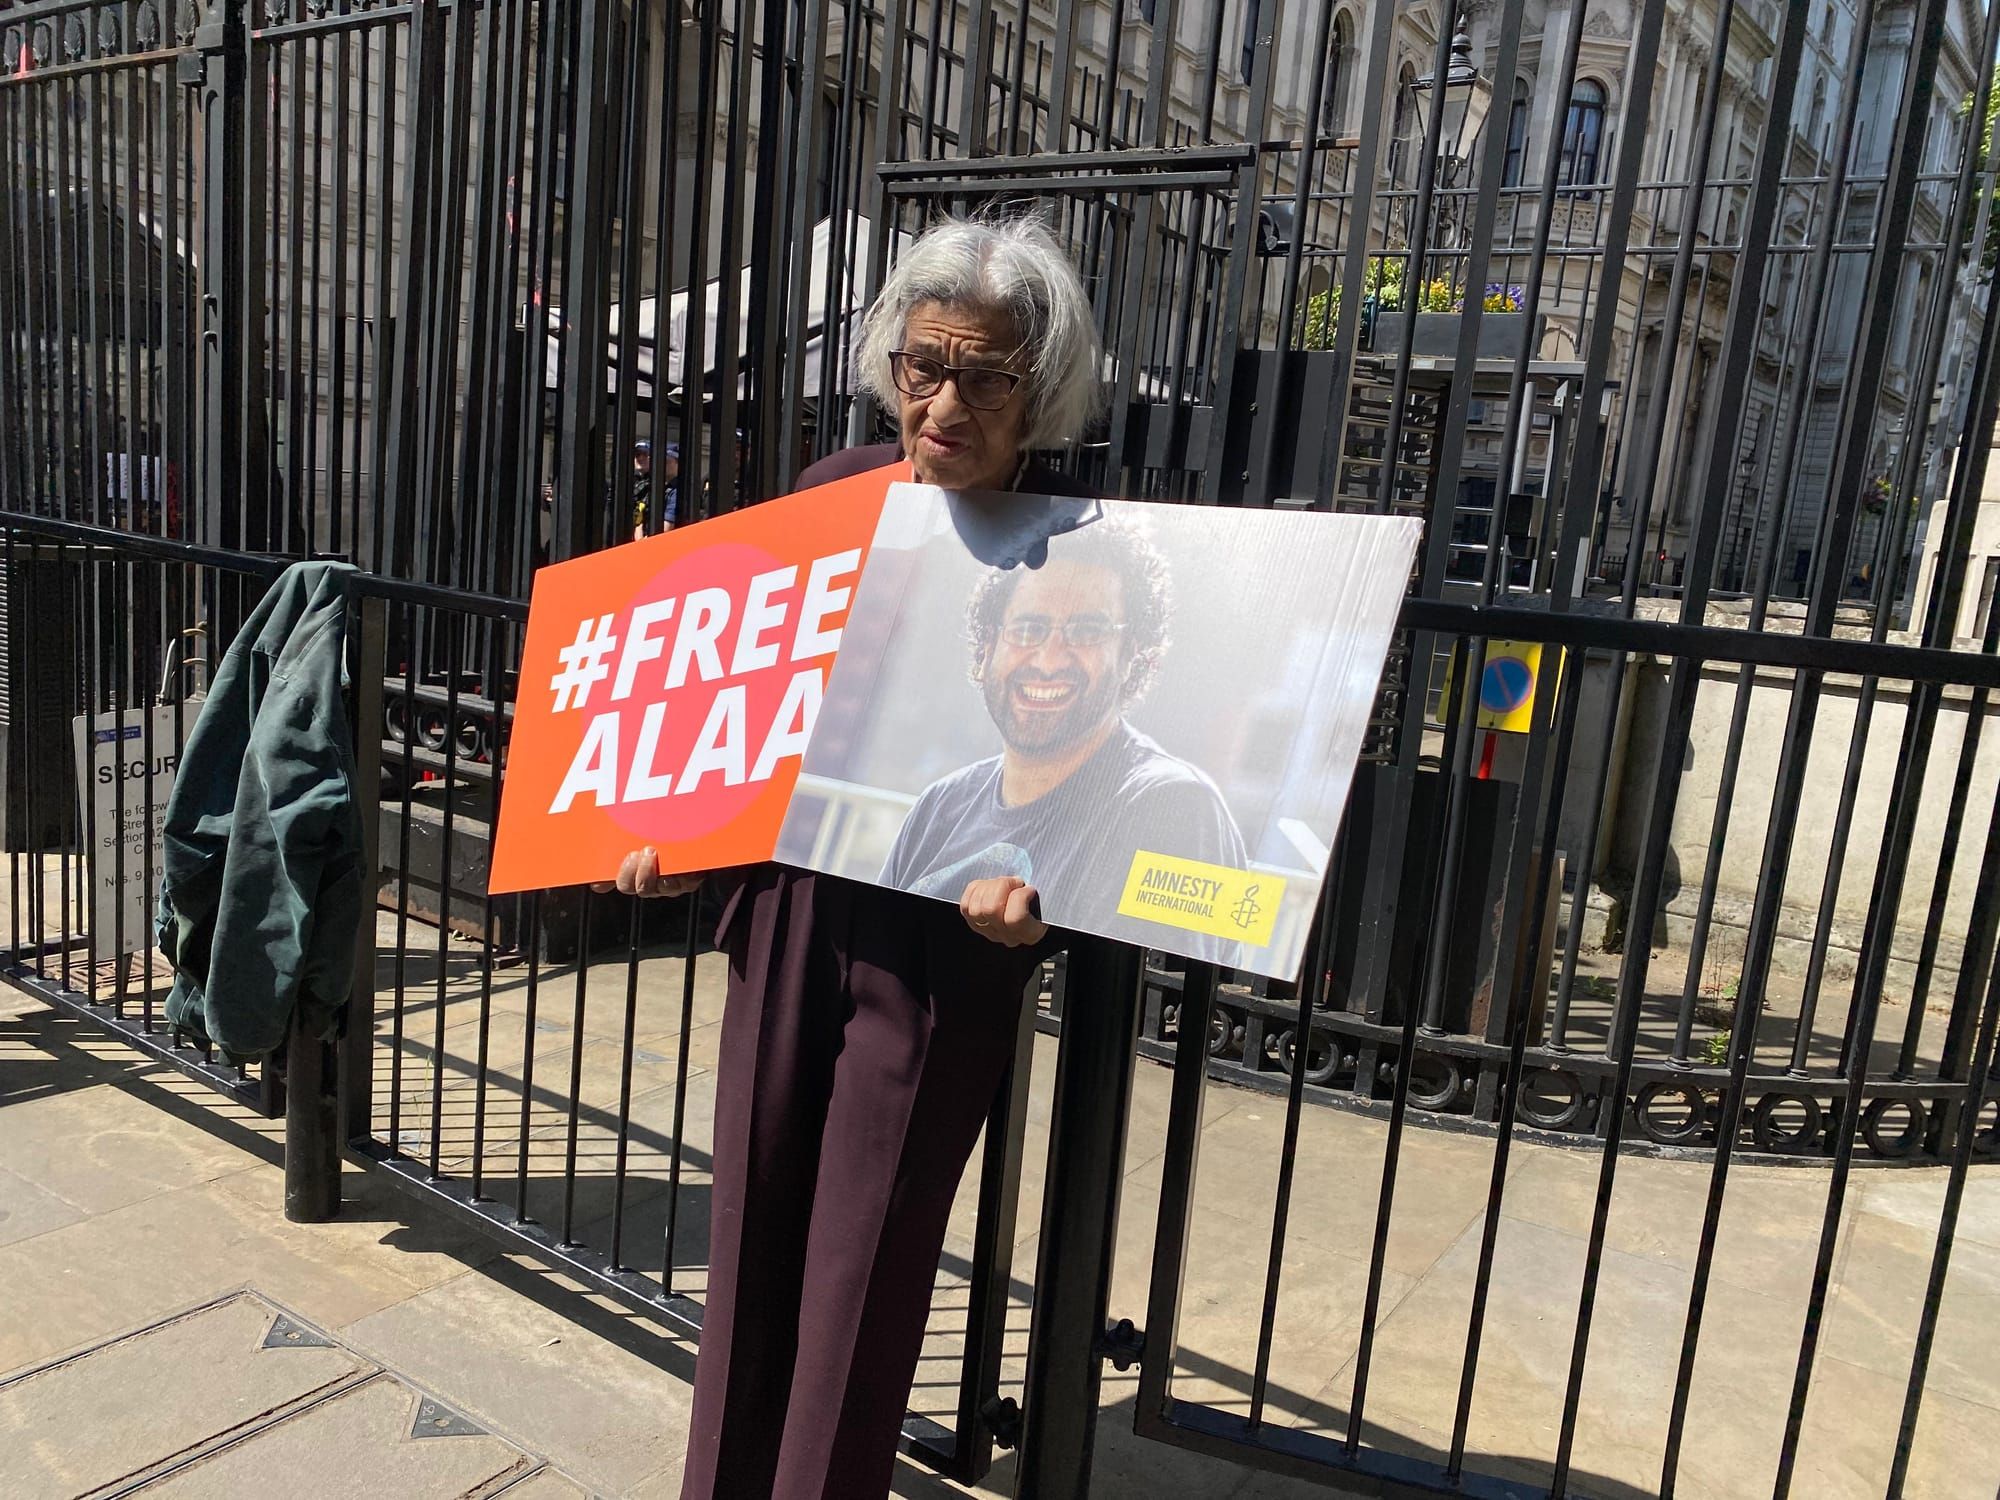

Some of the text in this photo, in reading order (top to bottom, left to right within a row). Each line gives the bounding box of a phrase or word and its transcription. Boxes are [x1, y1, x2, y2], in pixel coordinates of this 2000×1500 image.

[550, 548, 862, 714] #FREE
[548, 667, 824, 814] ALAA
[98, 755, 177, 784] SECUR
[109, 808, 132, 820] Te
[1141, 868, 1224, 901] AMNESTY
[1136, 890, 1215, 918] INTERNATIONAL
